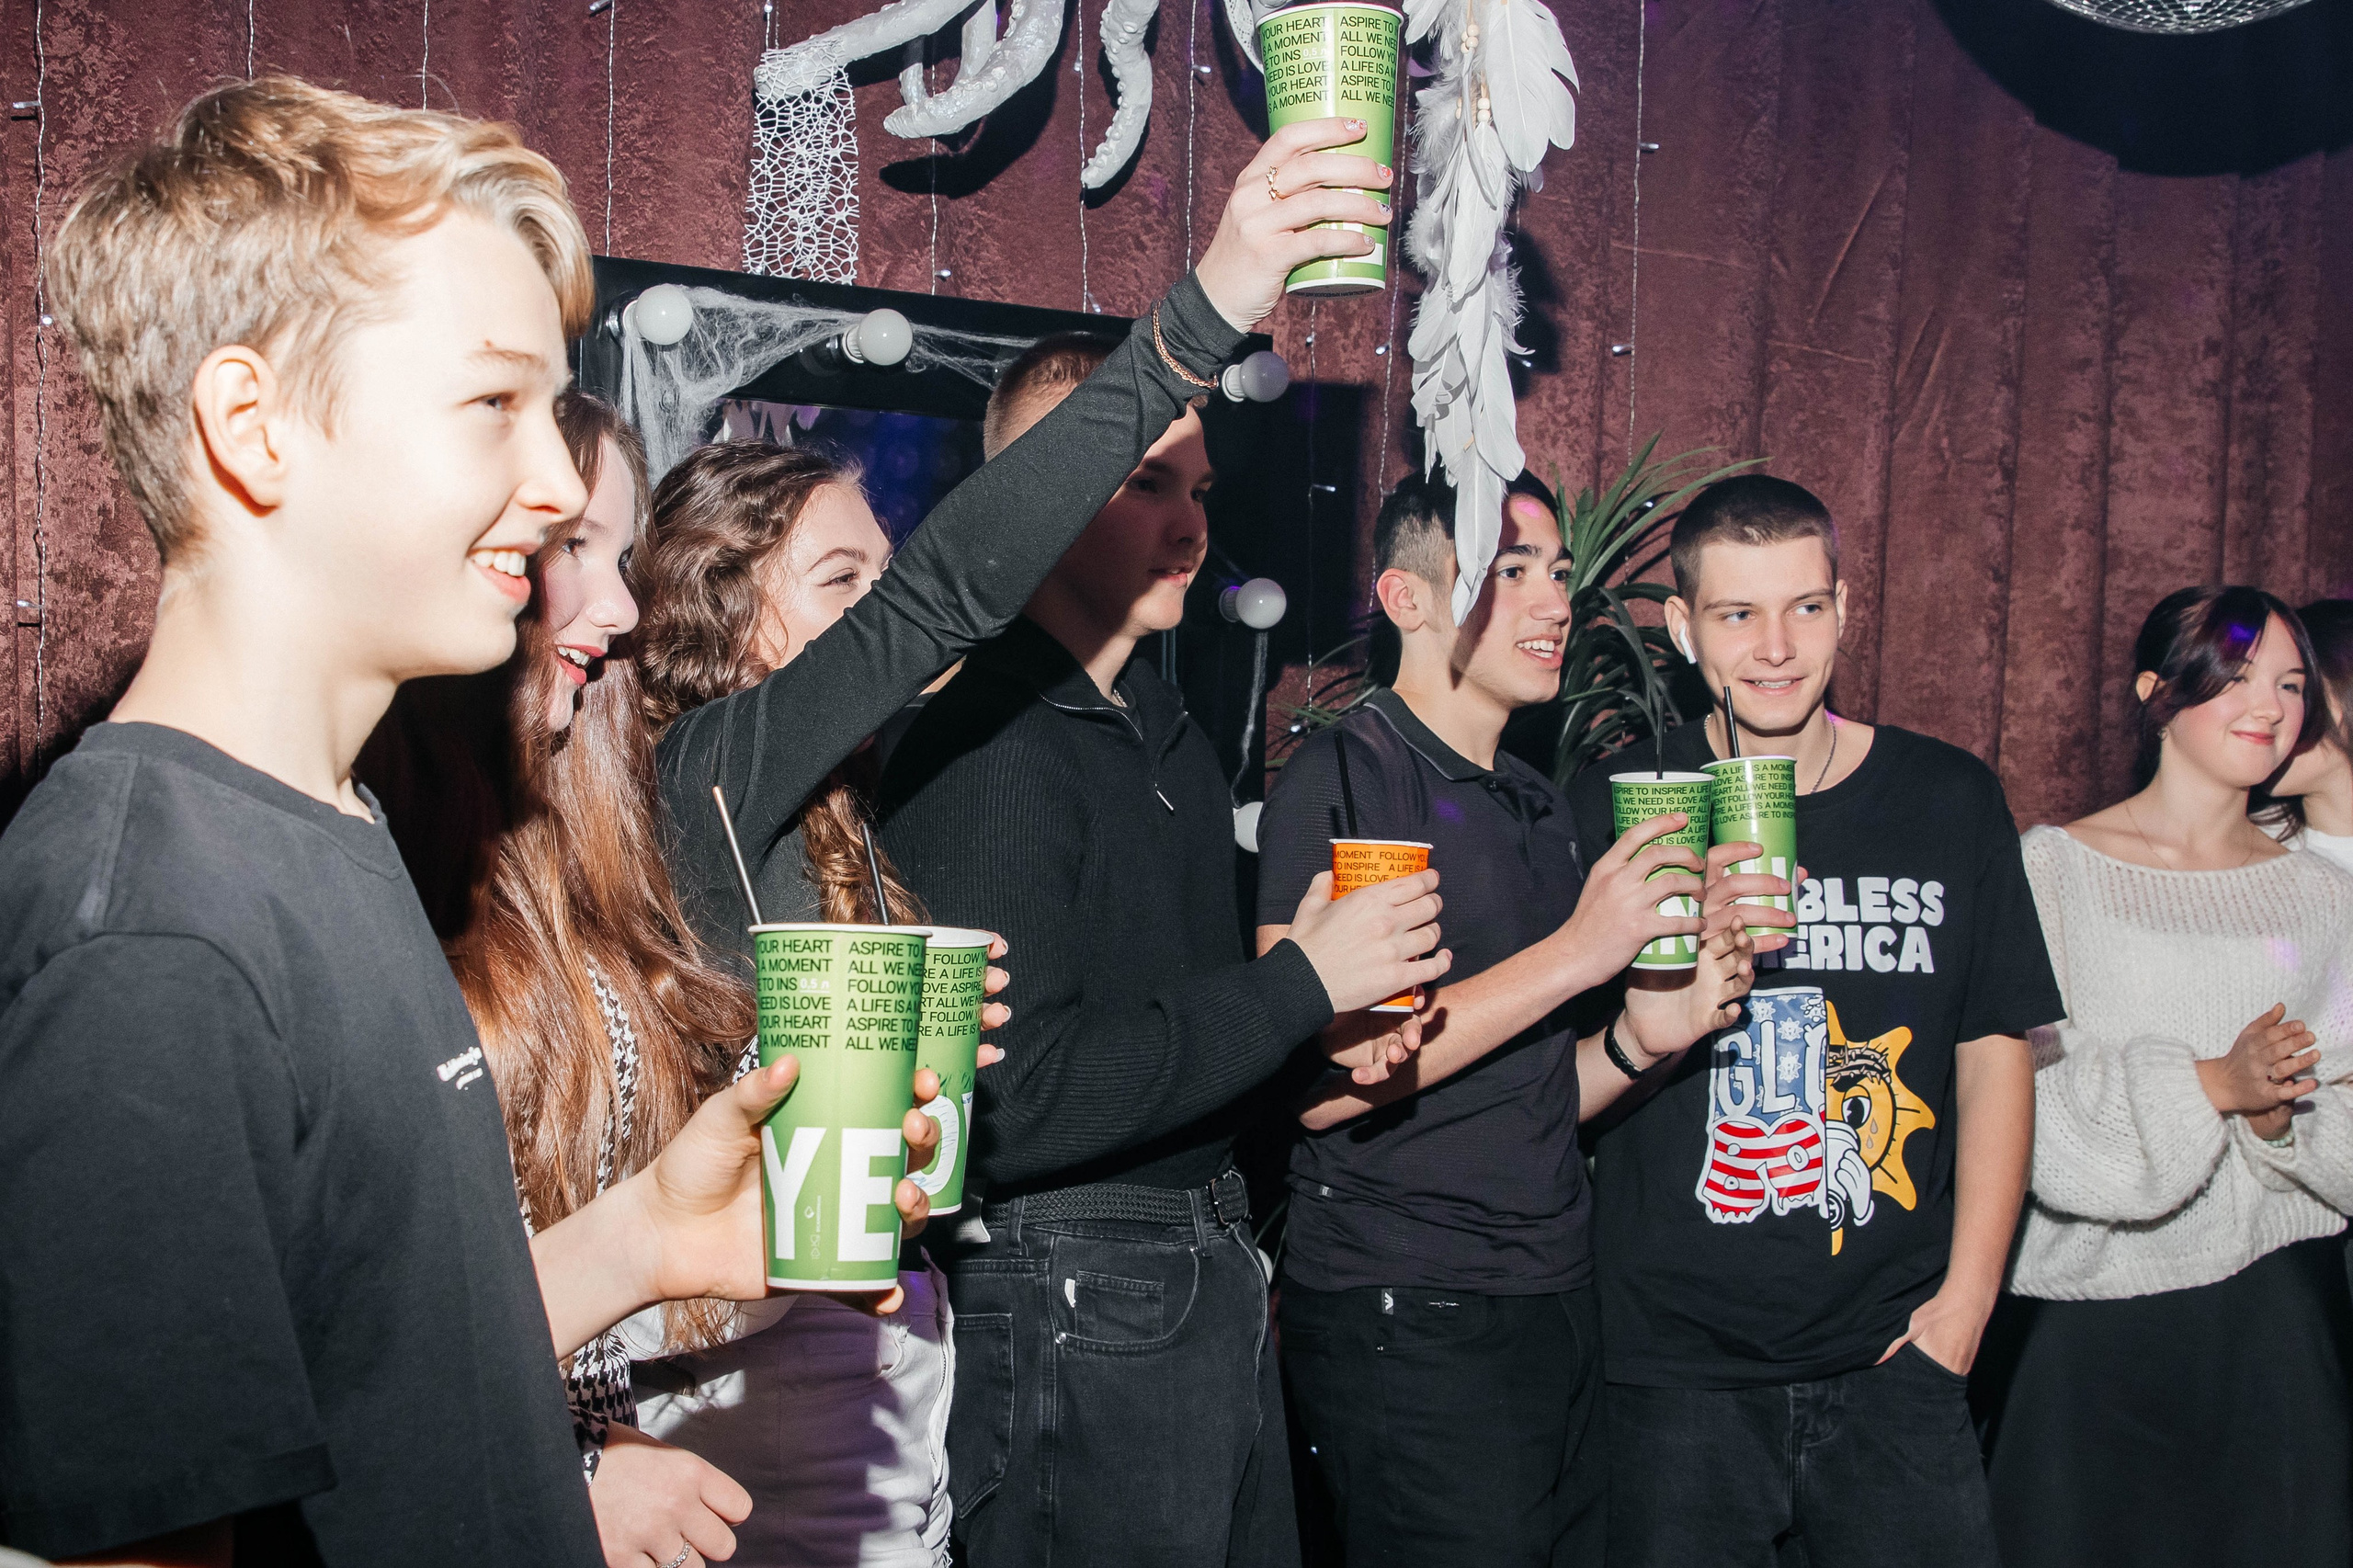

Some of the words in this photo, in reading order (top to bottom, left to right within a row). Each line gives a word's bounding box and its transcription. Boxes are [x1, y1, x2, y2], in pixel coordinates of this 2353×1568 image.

[1262, 23, 1283, 41] YOUR
[1286, 17, 1327, 32] HEART
[1340, 16, 1381, 30] ASPIRE
[1383, 20, 1393, 33] TO
[1267, 43, 1272, 53] A
[1274, 31, 1327, 51] MOMENT
[1340, 30, 1362, 42] ALL
[1366, 31, 1382, 45] WE
[1384, 36, 1397, 51] NEE
[1269, 54, 1279, 67] TO
[1282, 50, 1301, 62] INS
[1340, 45, 1385, 60] FOLLOW
[1387, 51, 1396, 64] YO
[1286, 65, 1295, 77] IS
[1297, 61, 1329, 75] LOVE
[1340, 60, 1349, 72] A
[1351, 60, 1374, 73] LIFE
[1375, 62, 1383, 74] IS
[1384, 65, 1390, 77] A
[1267, 82, 1288, 98] YOUR
[1290, 75, 1328, 90] HEART
[1340, 74, 1379, 88] ASPIRE
[1381, 79, 1391, 92] TO
[1273, 100, 1278, 110] A
[1279, 90, 1329, 109] MOMENT
[1341, 89, 1362, 101] ALL
[1365, 90, 1381, 104] WE
[1382, 94, 1394, 108] NEE
[1713, 777, 1733, 787] LOVE
[1734, 773, 1767, 783] ASIRE
[1768, 782, 1787, 790] NEED
[1634, 787, 1649, 795] TO
[1651, 786, 1688, 795] INSPIRE
[1696, 785, 1709, 793] LIFE
[1728, 792, 1762, 803] FOLLOW
[1764, 791, 1786, 800] YOUR
[1638, 797, 1663, 805] NEED
[1677, 796, 1697, 804] LOVE
[1734, 802, 1752, 812] LIFE
[1755, 801, 1762, 810] IS
[1642, 807, 1666, 815] YOUR
[1669, 806, 1696, 814] HEART
[1689, 815, 1708, 824] FOLLO
[1720, 814, 1737, 824] LOVE
[1666, 836, 1675, 845] IS
[1677, 835, 1696, 845] LOVE
[1379, 851, 1416, 861] FOLLOW
[1344, 862, 1381, 871] INSPIRE
[1397, 864, 1414, 872] LIFE
[1798, 877, 1944, 926] BLESS
[783, 939, 833, 953] HEART
[848, 941, 904, 957] ASPIRE
[907, 943, 919, 958] TO
[933, 952, 980, 965] FOLLOW
[761, 960, 767, 972] A
[768, 958, 833, 972] MOMENT
[847, 960, 878, 974] ALL
[883, 960, 904, 975] WE
[939, 969, 949, 979] A
[952, 967, 974, 979] LIFE
[975, 966, 982, 977] IS
[763, 977, 774, 991] TO
[777, 977, 798, 991] INS
[847, 979, 908, 994] FOLLOW
[910, 981, 920, 994] YO
[800, 978, 817, 989] 0.5
[922, 983, 948, 994] OVE
[950, 980, 982, 994] ASPIRE
[760, 996, 778, 1010] EED
[779, 995, 790, 1010] IS
[793, 995, 832, 1010] LOVE
[847, 998, 858, 1011] A
[861, 998, 892, 1013] LIFE
[894, 999, 905, 1014] IS
[905, 1000, 912, 1014] A
[936, 996, 958, 1007] ALL
[961, 995, 974, 1007] WE
[930, 1010, 973, 1022] FOLLOW
[783, 1015, 832, 1029] HEART
[846, 1017, 898, 1032] ASPIRE
[901, 1018, 913, 1033] TO
[935, 1026, 944, 1037] A
[948, 1024, 968, 1037] LIFE
[970, 1023, 976, 1034] IS
[763, 1035, 768, 1048] A
[770, 1034, 831, 1048] MOMENT
[845, 1036, 874, 1050] ALL
[879, 1037, 899, 1051] WE
[760, 1125, 905, 1262] YE
